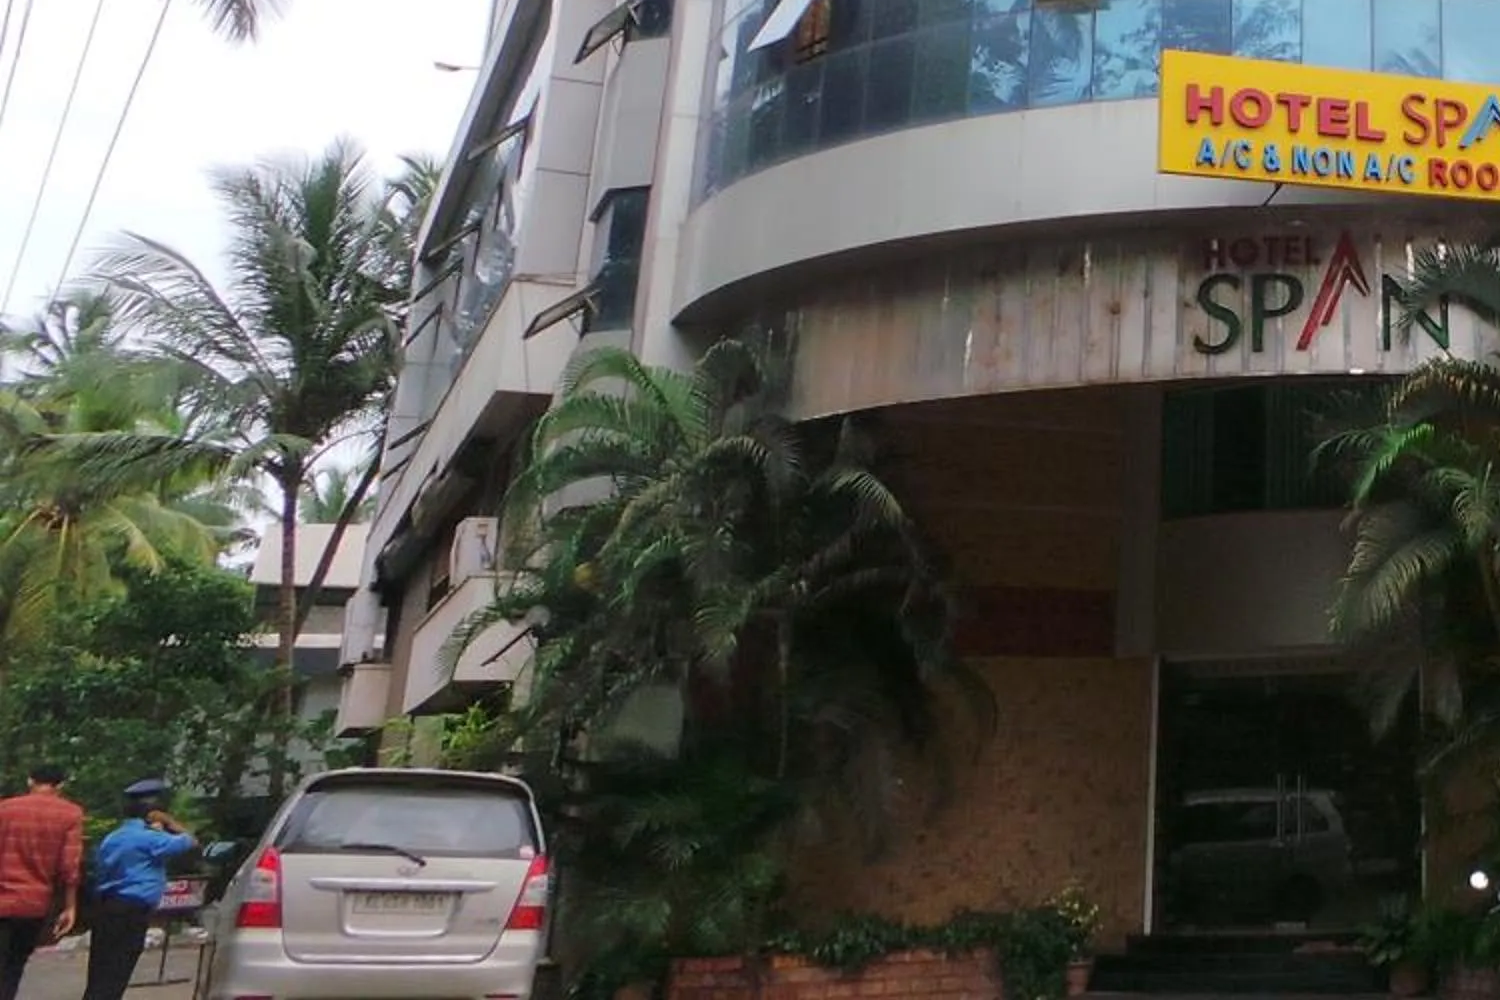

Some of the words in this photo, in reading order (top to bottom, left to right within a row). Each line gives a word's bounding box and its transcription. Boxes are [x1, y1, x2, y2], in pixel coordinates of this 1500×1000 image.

[1185, 83, 1385, 142] HOTEL
[1196, 137, 1251, 170] A/C
[1262, 144, 1280, 172] &
[1291, 145, 1355, 181] NON
[1363, 151, 1417, 184] A/C
[1202, 236, 1322, 269] HOTEL
[1193, 230, 1449, 354] SPAN
